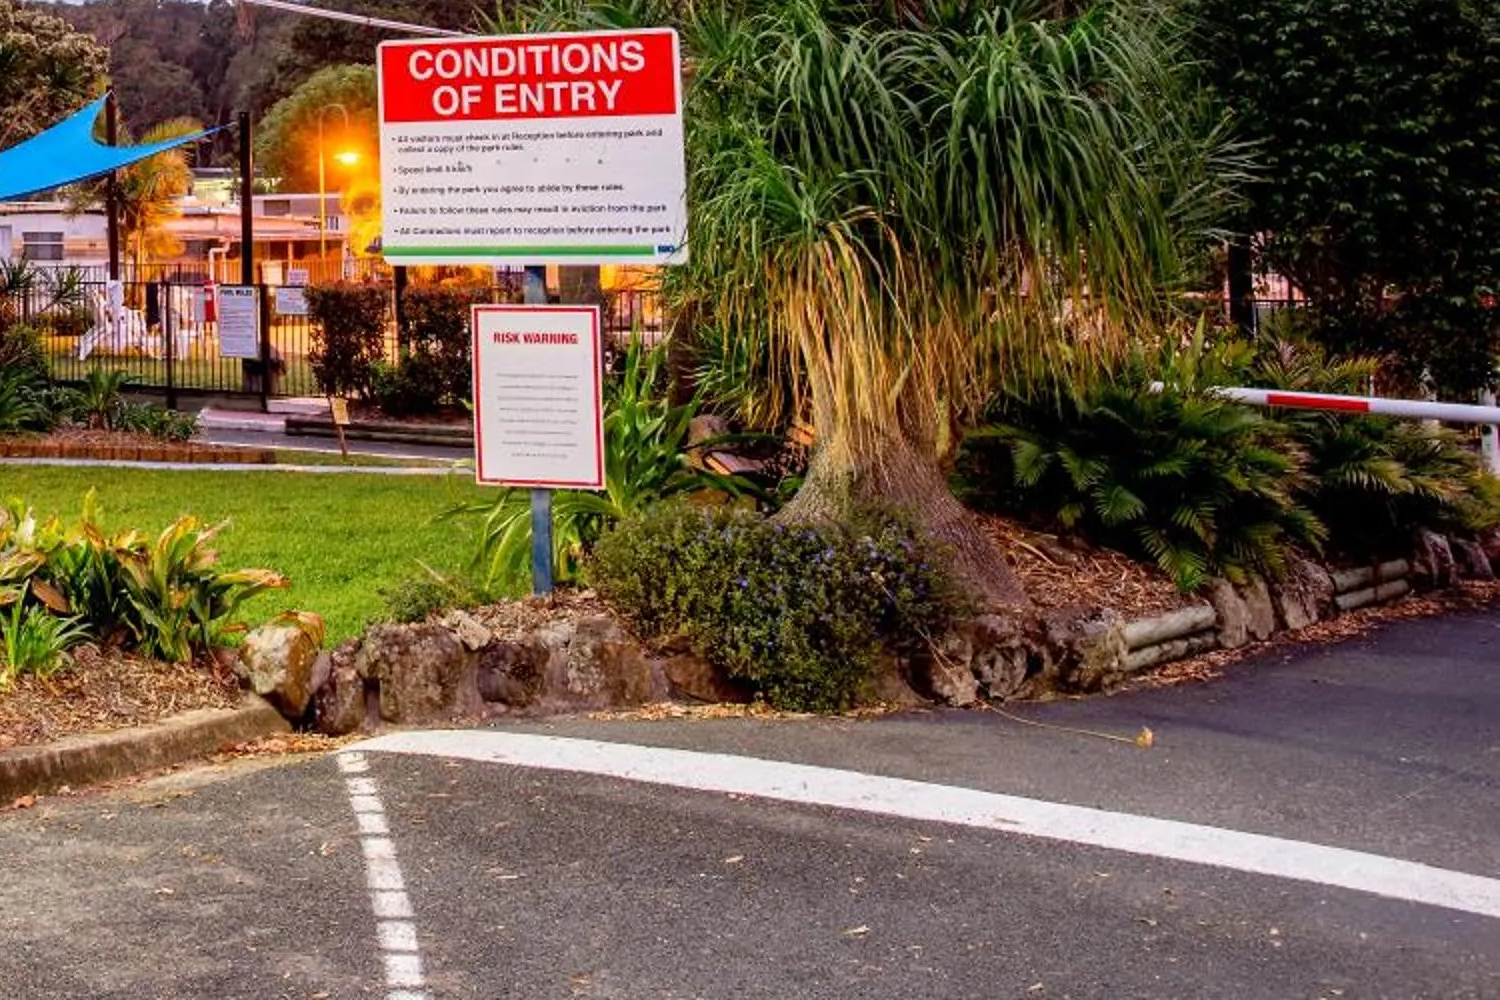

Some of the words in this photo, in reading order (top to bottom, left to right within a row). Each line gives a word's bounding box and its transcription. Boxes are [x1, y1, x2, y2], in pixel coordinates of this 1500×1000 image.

[408, 40, 645, 81] CONDITIONS
[432, 85, 483, 116] OF
[495, 79, 623, 114] ENTRY
[493, 332, 520, 344] RISK
[523, 332, 579, 345] WARNING
